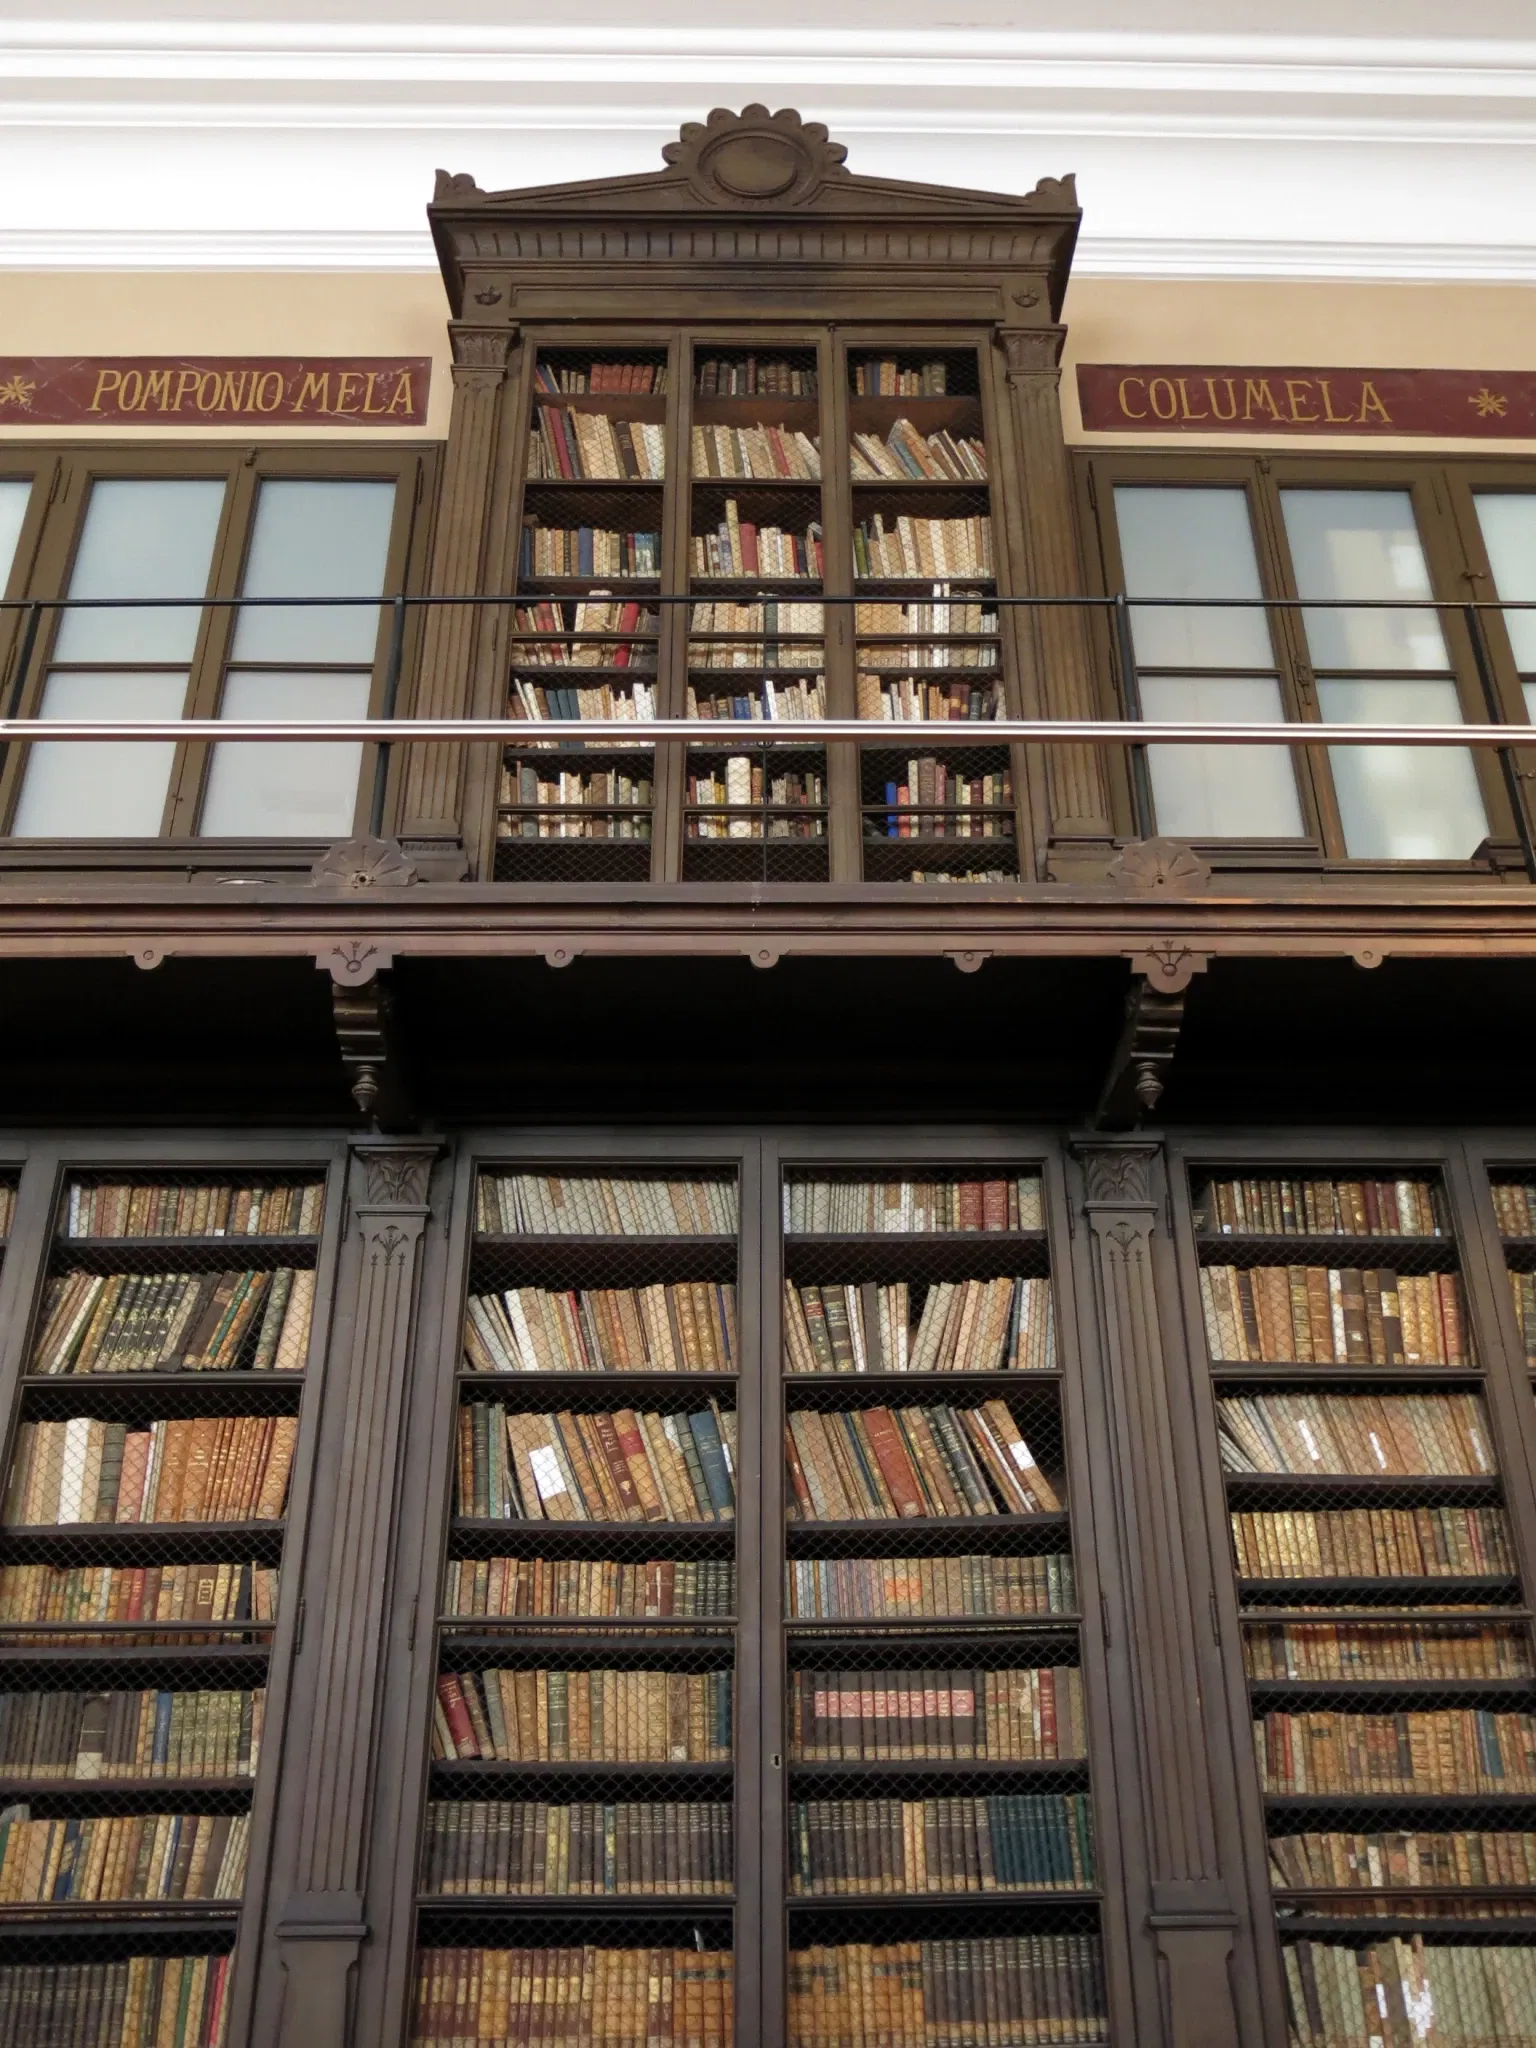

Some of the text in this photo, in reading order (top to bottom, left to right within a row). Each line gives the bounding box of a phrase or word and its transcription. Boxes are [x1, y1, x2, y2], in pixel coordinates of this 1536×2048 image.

[87, 370, 414, 414] POMPONIO MELA
[1118, 377, 1393, 423] COLUMELA
